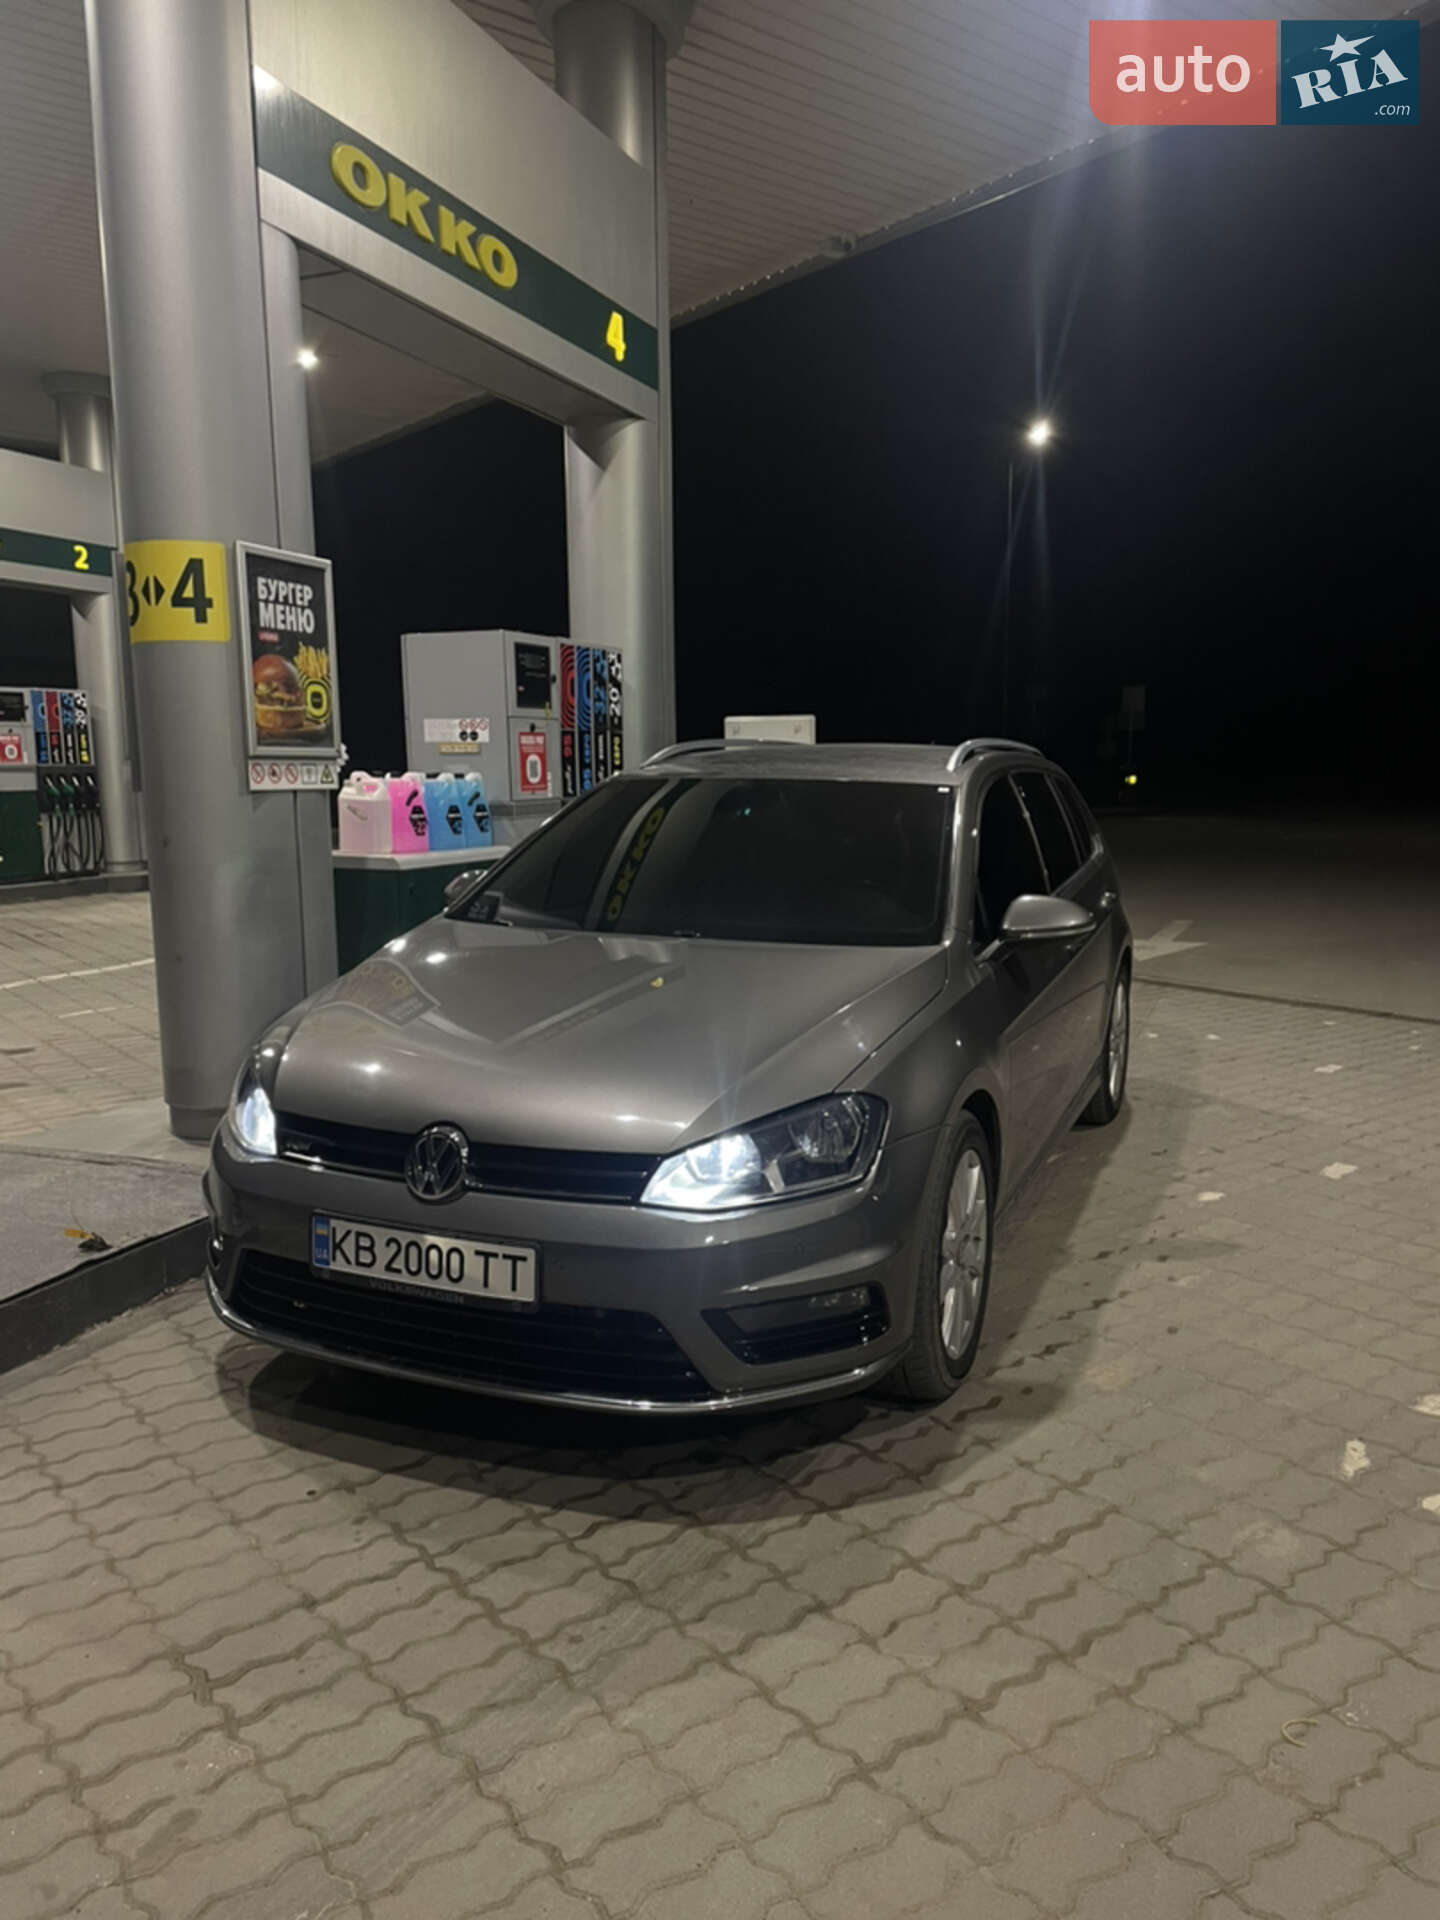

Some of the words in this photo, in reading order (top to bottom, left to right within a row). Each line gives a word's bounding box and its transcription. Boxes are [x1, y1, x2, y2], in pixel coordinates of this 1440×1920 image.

[331, 141, 518, 289] OKKO
[606, 311, 626, 362] 4
[73, 544, 89, 570] 2
[170, 557, 214, 624] 4
[256, 576, 313, 607] БУРГЕР
[259, 602, 315, 634] МЕНЮ
[331, 1226, 377, 1269] KB
[384, 1236, 465, 1283] 2000
[474, 1249, 528, 1293] TT
